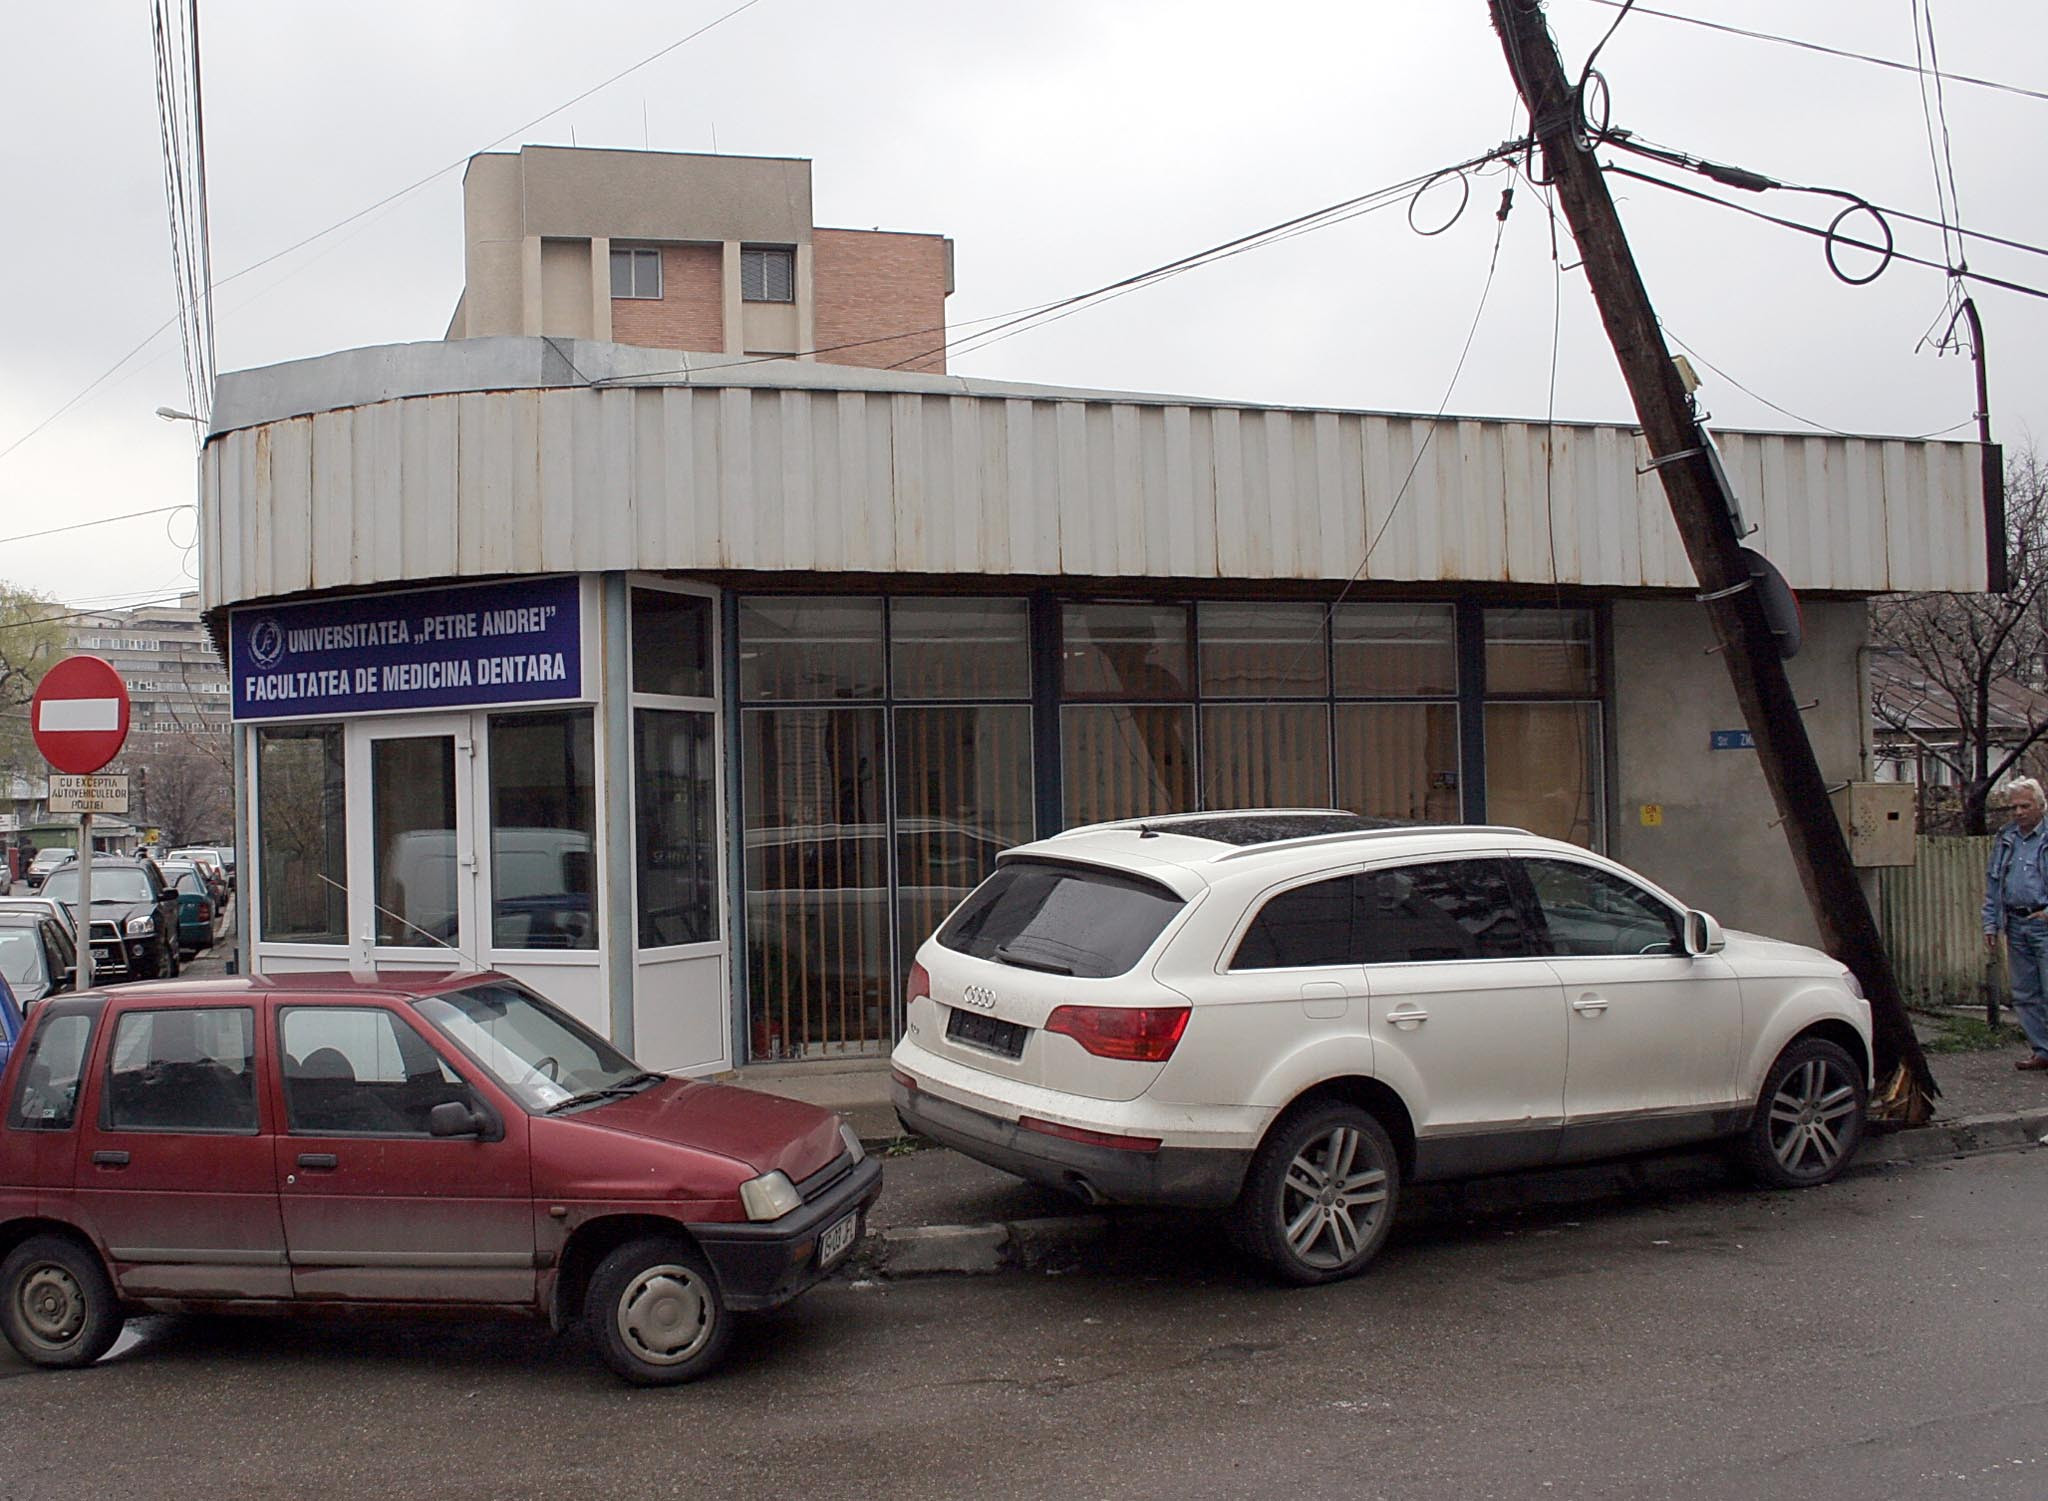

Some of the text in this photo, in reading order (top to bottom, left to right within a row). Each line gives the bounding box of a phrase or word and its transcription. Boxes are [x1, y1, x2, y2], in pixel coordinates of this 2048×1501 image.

[288, 619, 409, 653] UNIVERSITATEA
[246, 652, 567, 702] FACULTATEA DE MEDICINA DENTARA
[51, 788, 128, 799] AUTOVEHICULELOR
[60, 777, 118, 788] CU EXCEPTIA
